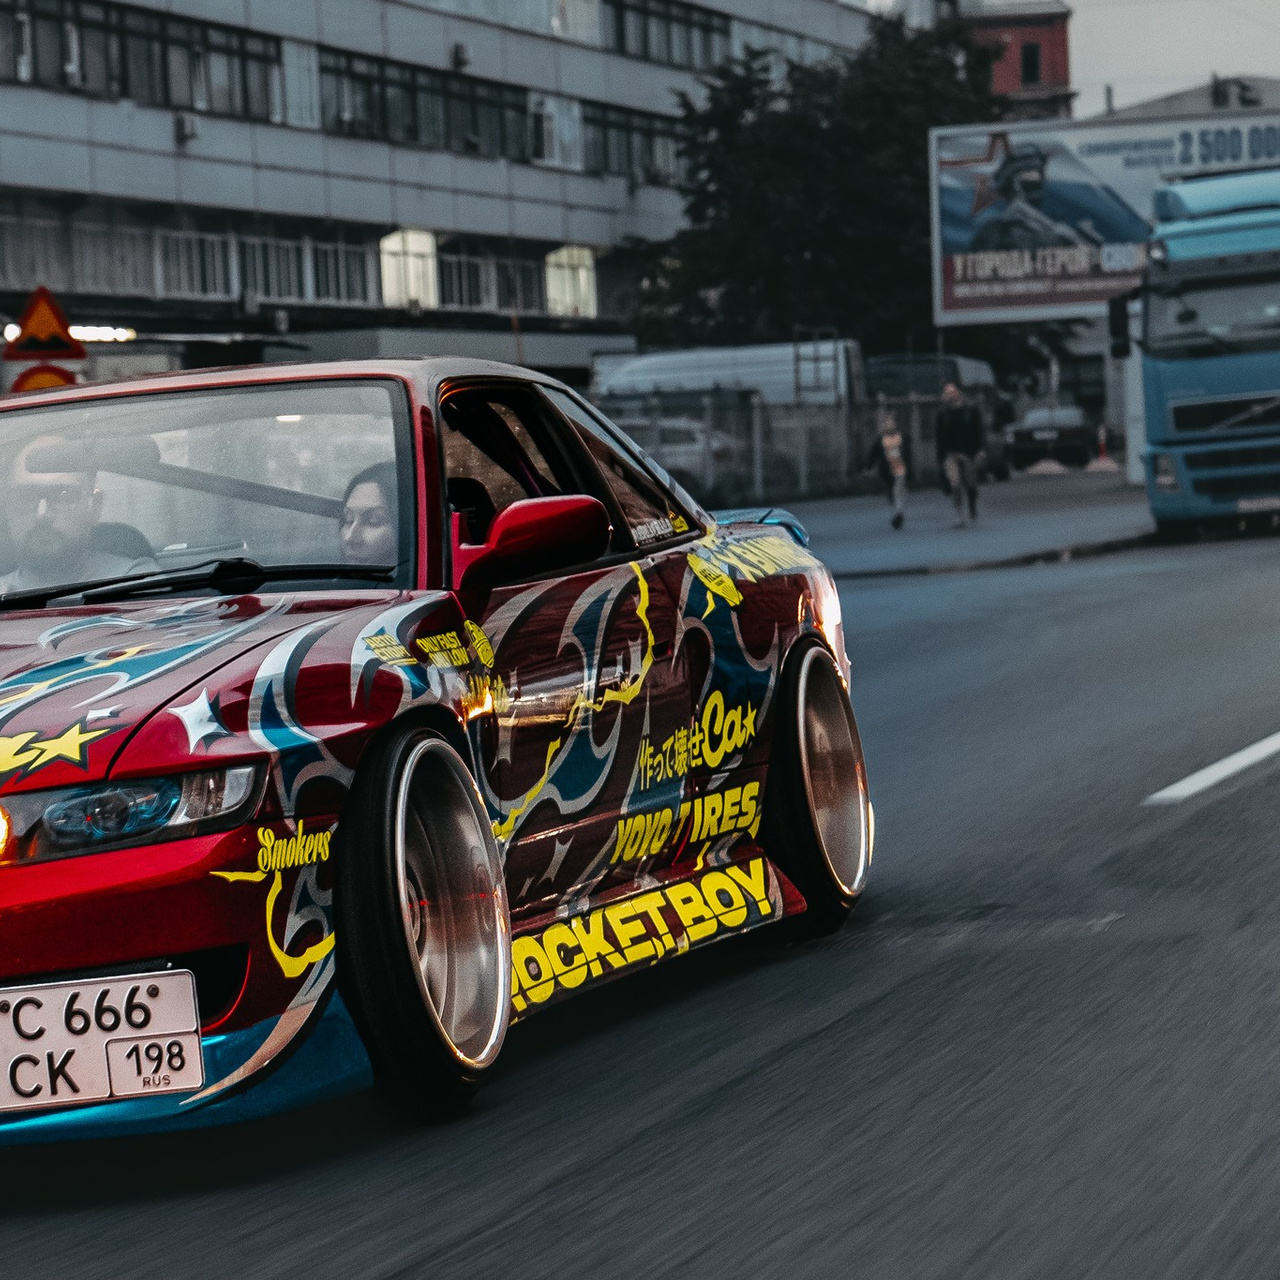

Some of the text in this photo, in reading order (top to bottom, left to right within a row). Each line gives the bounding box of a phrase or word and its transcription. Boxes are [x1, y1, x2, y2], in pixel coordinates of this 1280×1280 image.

[416, 631, 462, 653] ONLY FAST
[671, 781, 761, 845] TIRES
[257, 819, 332, 872] Smokers
[64, 984, 152, 1036] 666
[125, 1039, 186, 1077] 198
[142, 1074, 171, 1088] RUS
